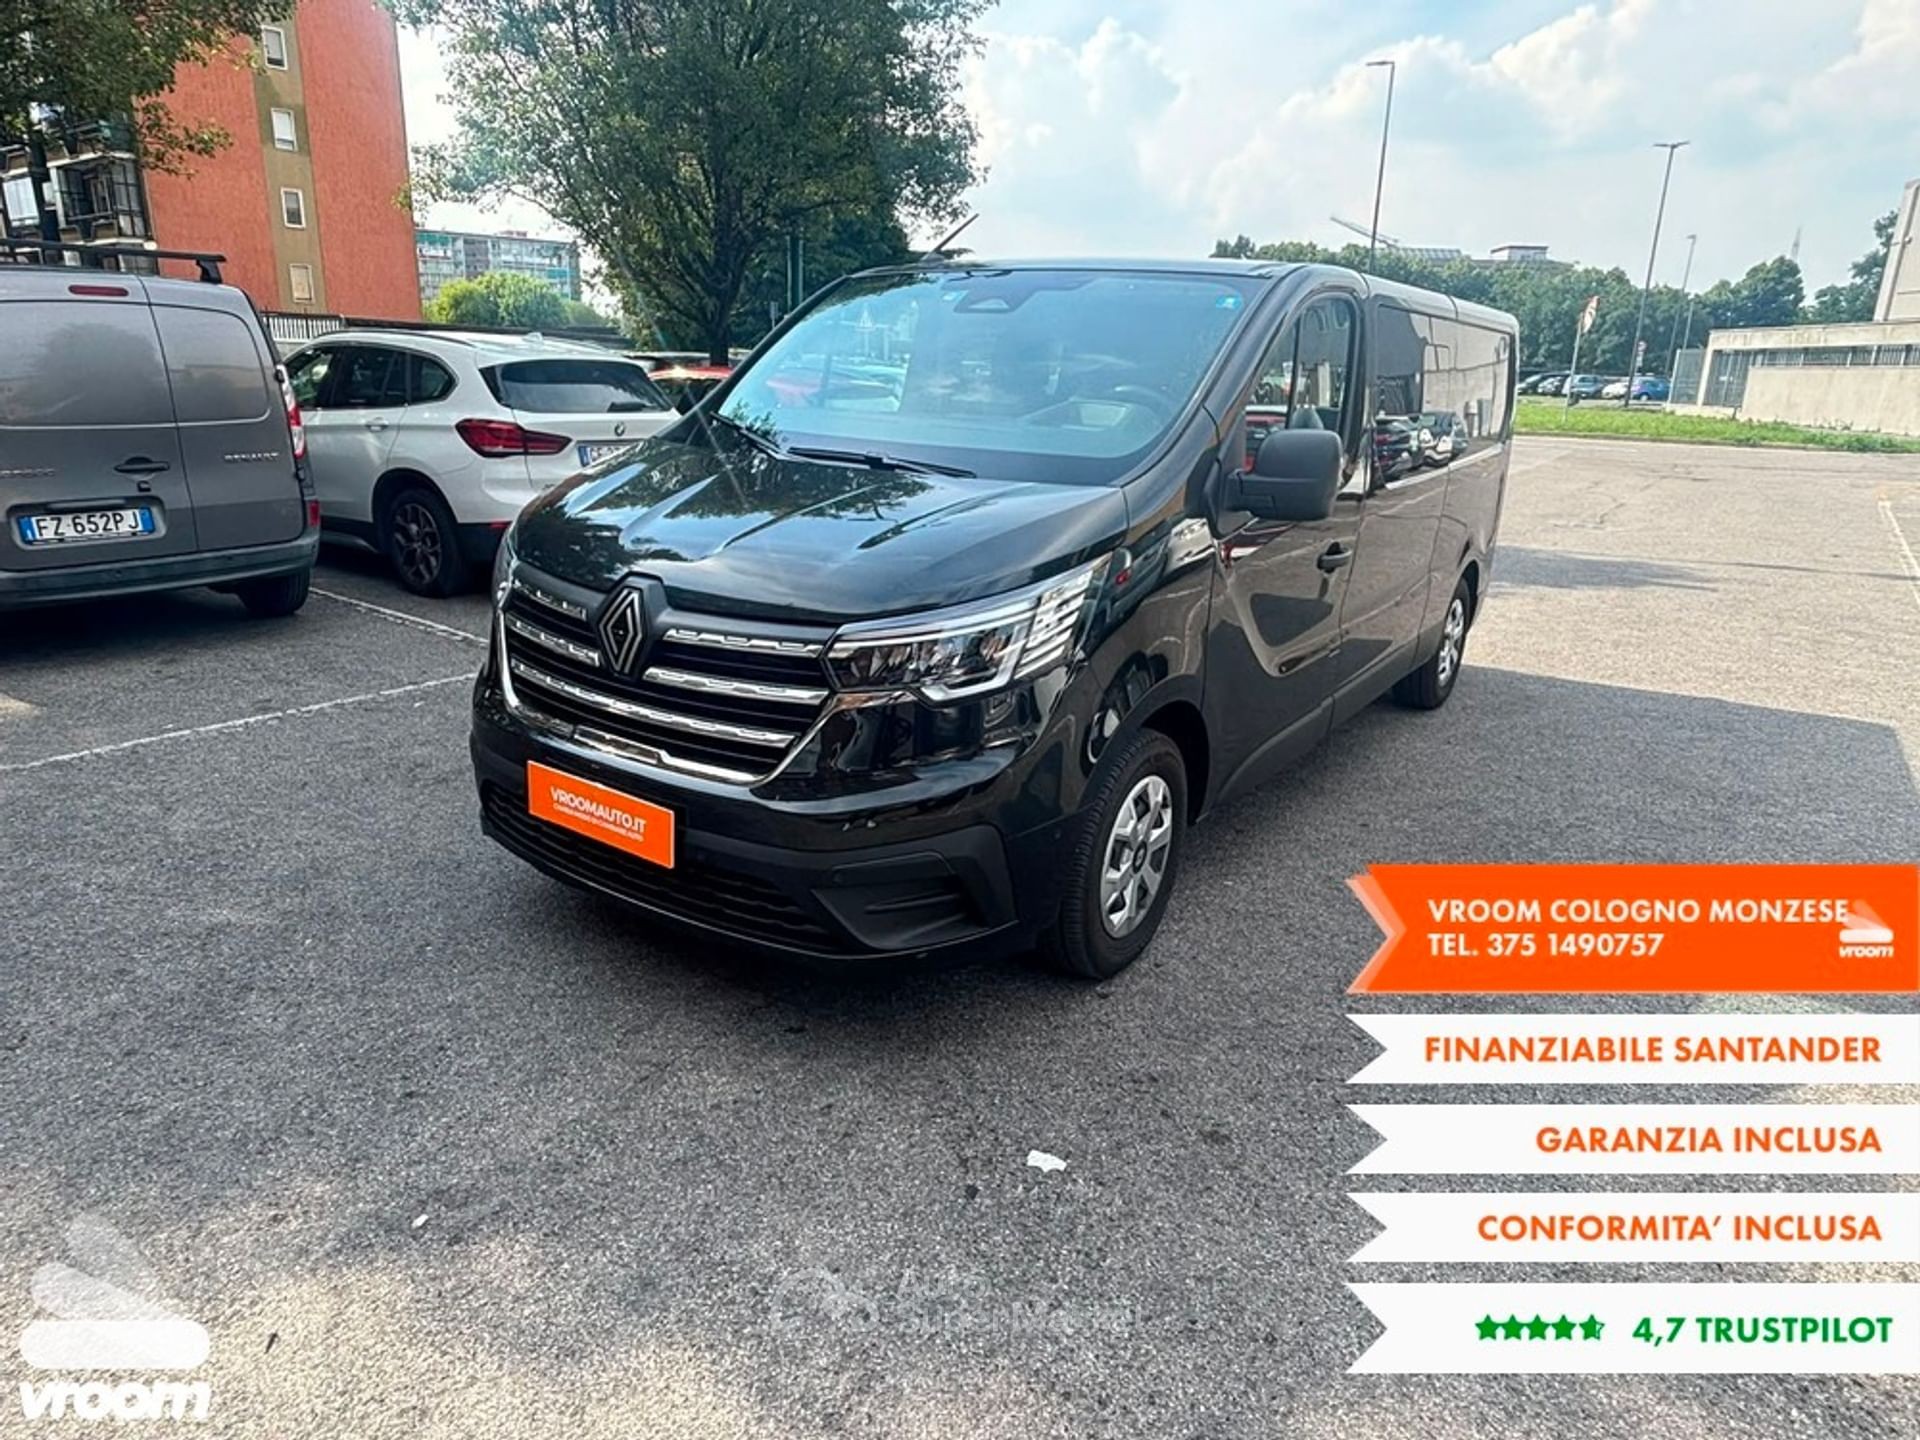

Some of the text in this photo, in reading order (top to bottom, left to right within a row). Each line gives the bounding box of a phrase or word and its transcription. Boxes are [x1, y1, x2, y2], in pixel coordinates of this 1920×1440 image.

[36, 511, 140, 537] FZ 652PJ
[550, 786, 647, 833] VROOMAUTO.IT
